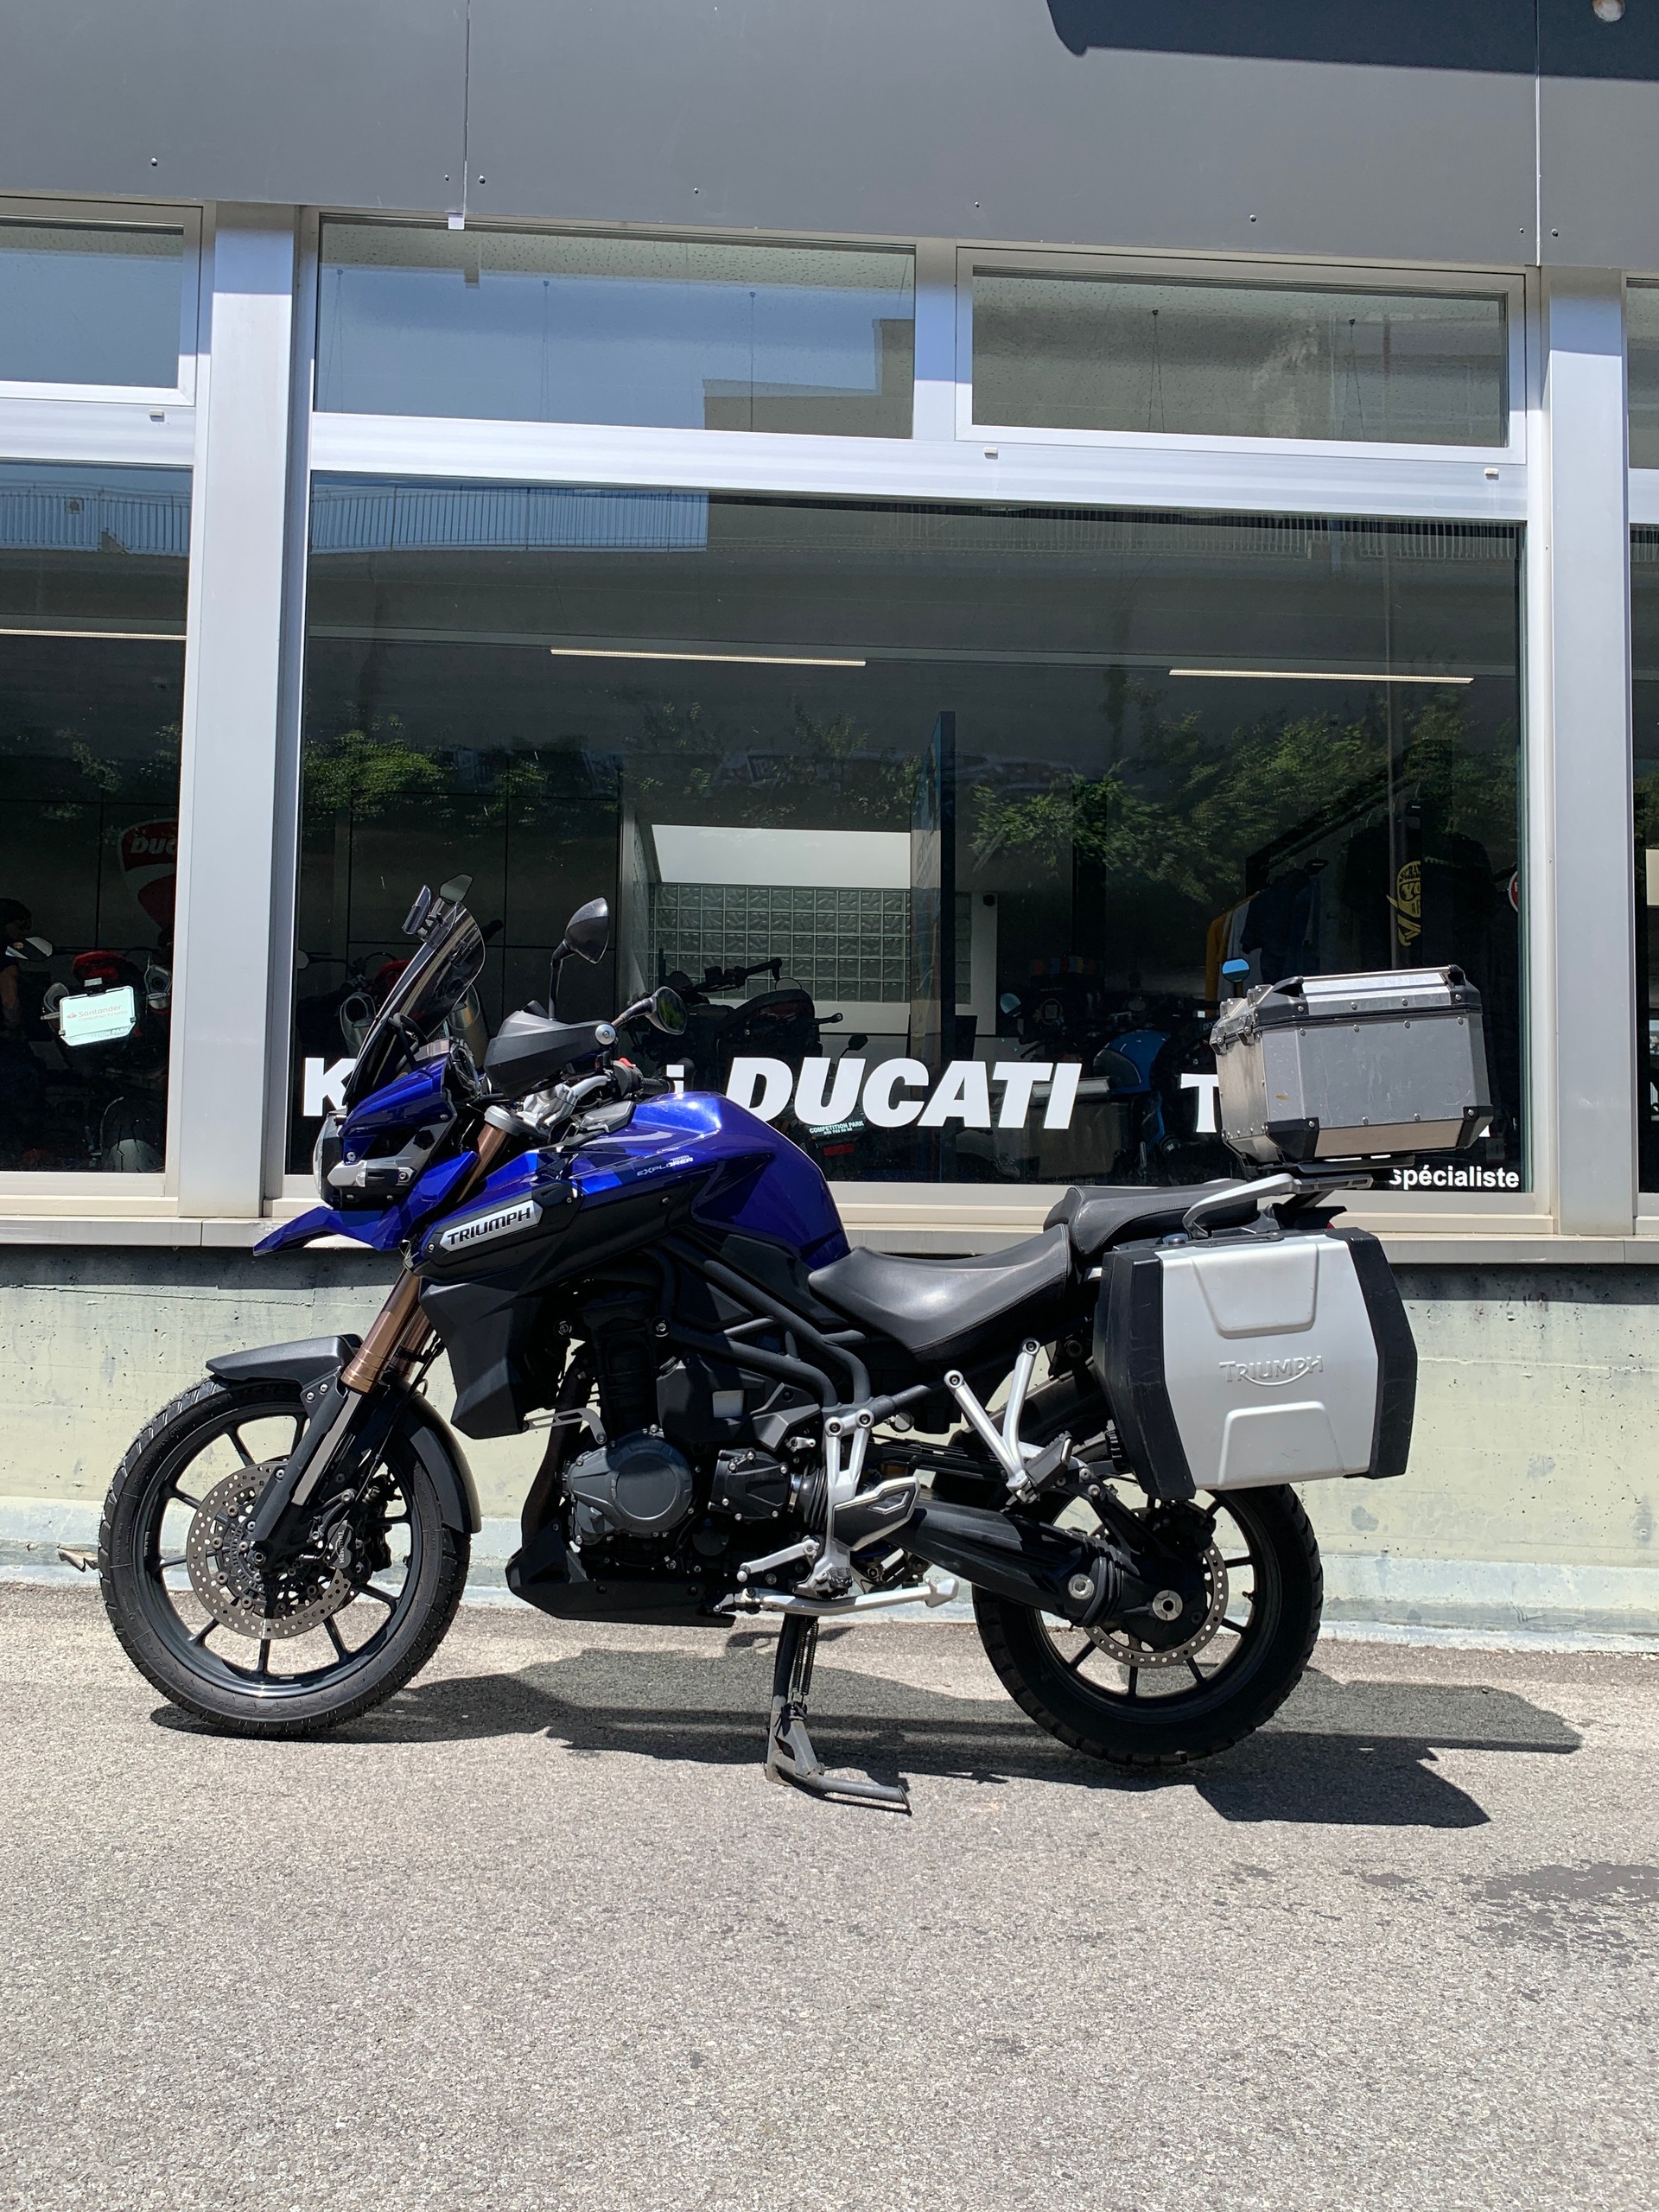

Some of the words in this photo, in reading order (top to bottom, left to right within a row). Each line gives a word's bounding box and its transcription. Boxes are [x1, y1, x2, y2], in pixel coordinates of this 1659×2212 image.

[130, 835, 178, 855] DUC
[79, 1004, 122, 1018] Santander
[726, 1057, 1082, 1130] DUCATI
[810, 1122, 848, 1134] COMPETITION
[849, 1120, 865, 1128] PARK
[637, 1157, 694, 1176] EXPLORER
[1389, 1165, 1520, 1190] spécialiste
[447, 1207, 531, 1245] TRIUMPH
[1218, 1355, 1324, 1385] TRIUMPH
